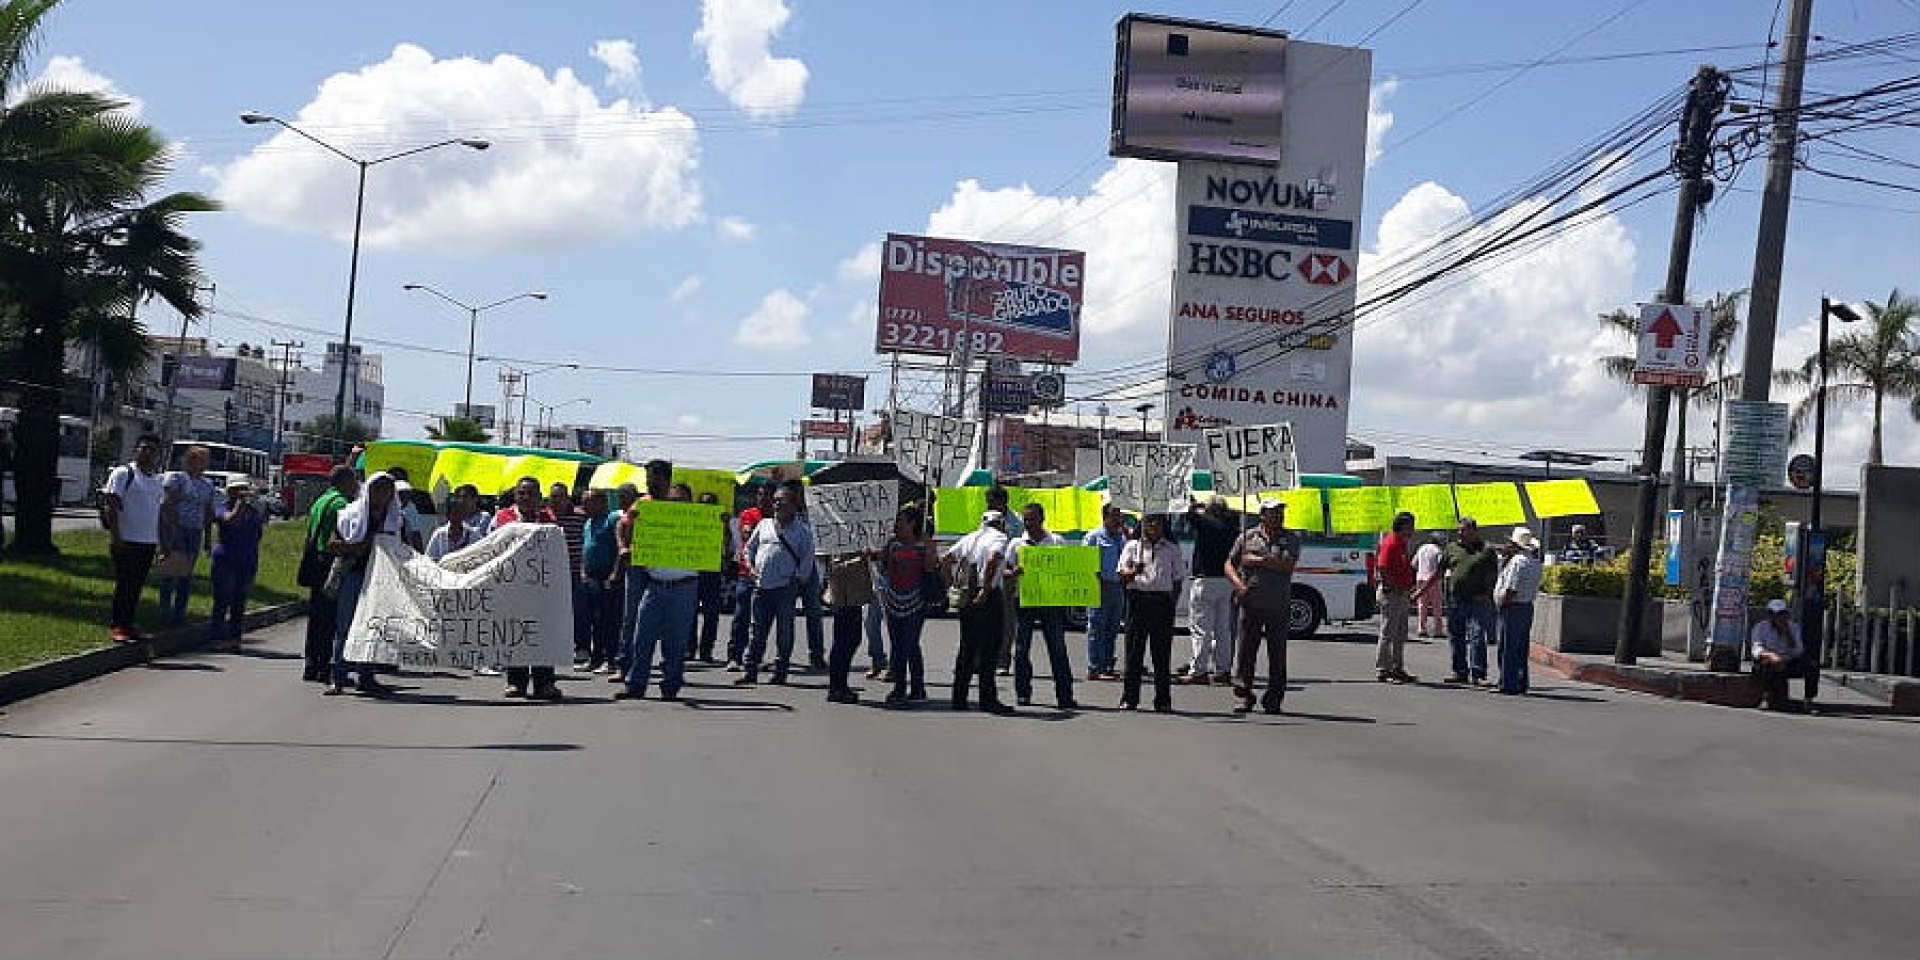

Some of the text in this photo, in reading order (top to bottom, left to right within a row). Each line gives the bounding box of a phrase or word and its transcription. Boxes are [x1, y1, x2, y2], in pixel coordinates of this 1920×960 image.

[1207, 176, 1314, 210] NOVUM
[888, 240, 1080, 288] Disponible
[1188, 243, 1292, 281] HSBC
[1179, 303, 1305, 325] ANA SEGUROS
[1181, 385, 1339, 409] COMIDA CHINA
[1208, 427, 1292, 462] FUERA
[813, 485, 889, 512] FUERA
[526, 558, 551, 587] SE
[430, 587, 494, 613] VENDE
[411, 617, 541, 647] DEFIENDE
